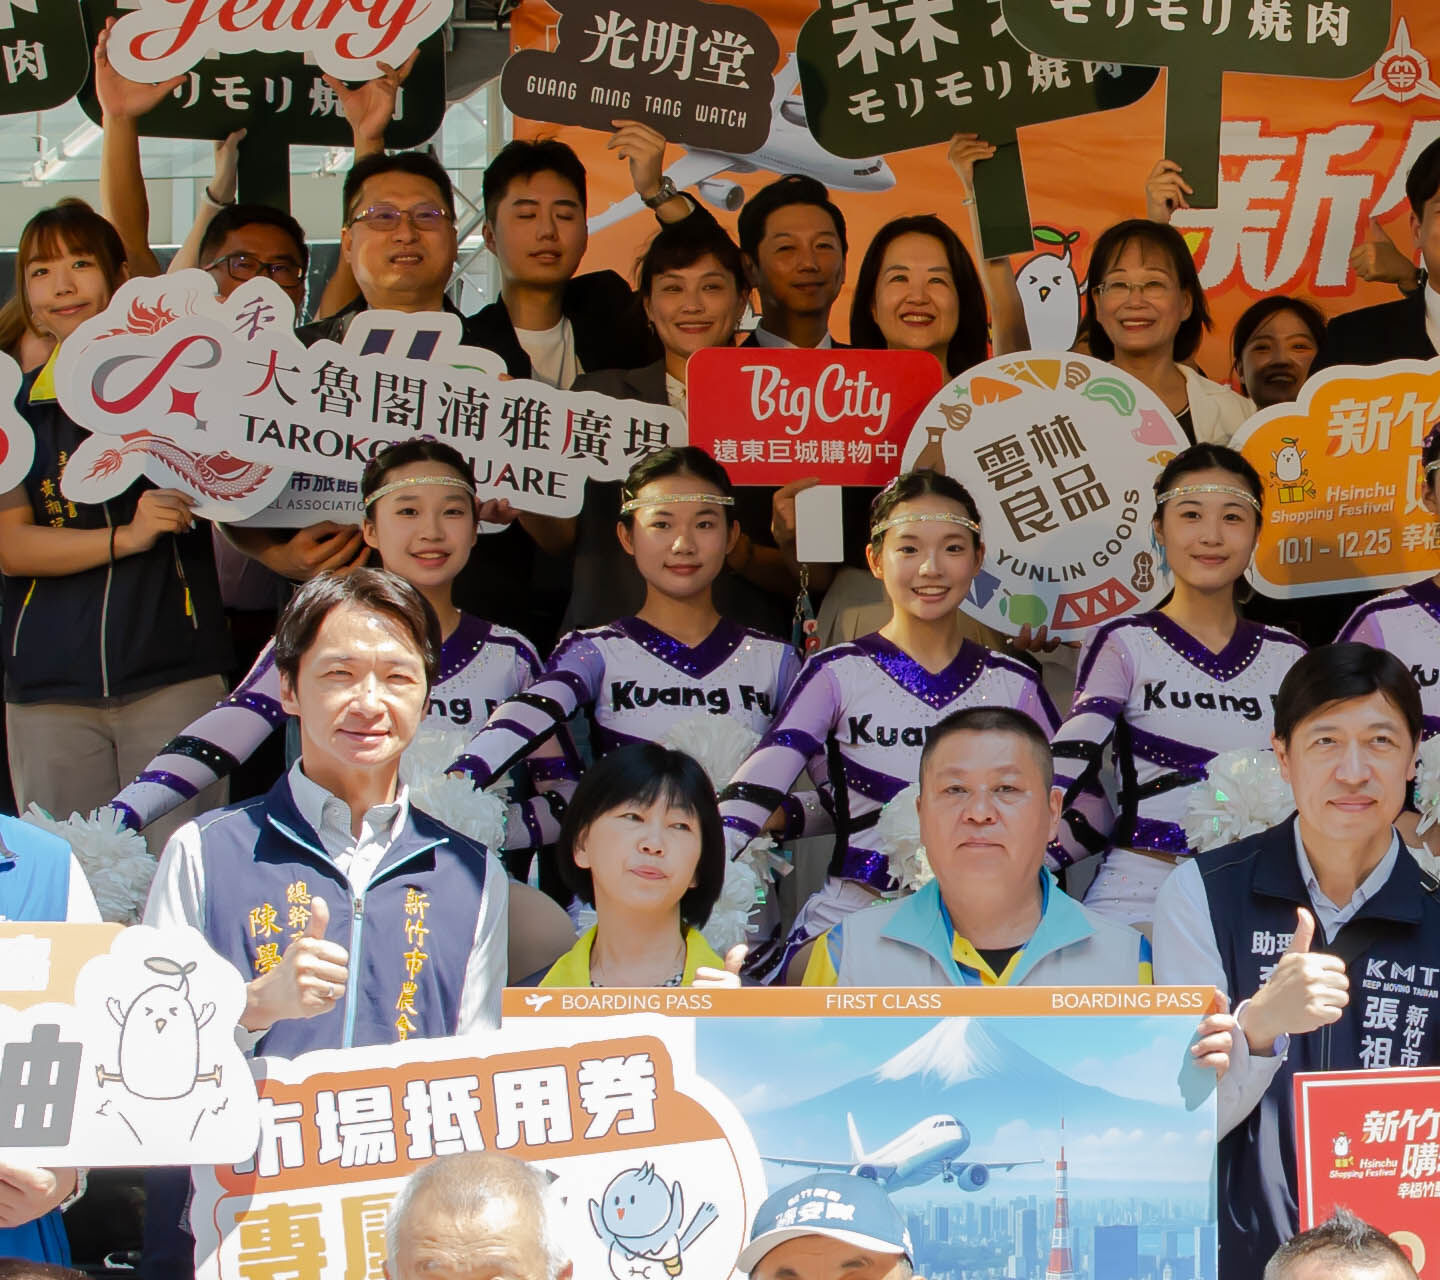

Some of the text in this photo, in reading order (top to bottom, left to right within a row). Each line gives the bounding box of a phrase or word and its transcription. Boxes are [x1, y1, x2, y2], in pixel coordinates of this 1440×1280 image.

[582, 9, 756, 91] 光明堂
[527, 75, 748, 129] GUANG MING TANG WATCH
[244, 348, 672, 466] 大魯閣湳雅廣場
[740, 363, 892, 436] BigCity
[713, 437, 899, 465] 遠東巨城購物中
[973, 413, 1088, 493] 雲林
[286, 499, 367, 513] ASSOCIATIO
[998, 462, 1111, 543] 良品
[1271, 500, 1394, 525] Shopping Festival
[1326, 483, 1396, 505] Hsinchu
[997, 488, 1140, 584] YUNLIN GOODS
[1277, 528, 1392, 565] 10.1 12.25
[611, 682, 731, 715] Kuang
[1144, 681, 1262, 721] Kuang
[395, 888, 429, 1040] 新竹市農會
[1365, 958, 1440, 986] KMT
[561, 991, 1203, 1011] BOARDING PASS FIRST CLASS BOARDING PASS
[1400, 1004, 1430, 1068] 新竹市
[231, 1052, 658, 1178] 市場抵用券
